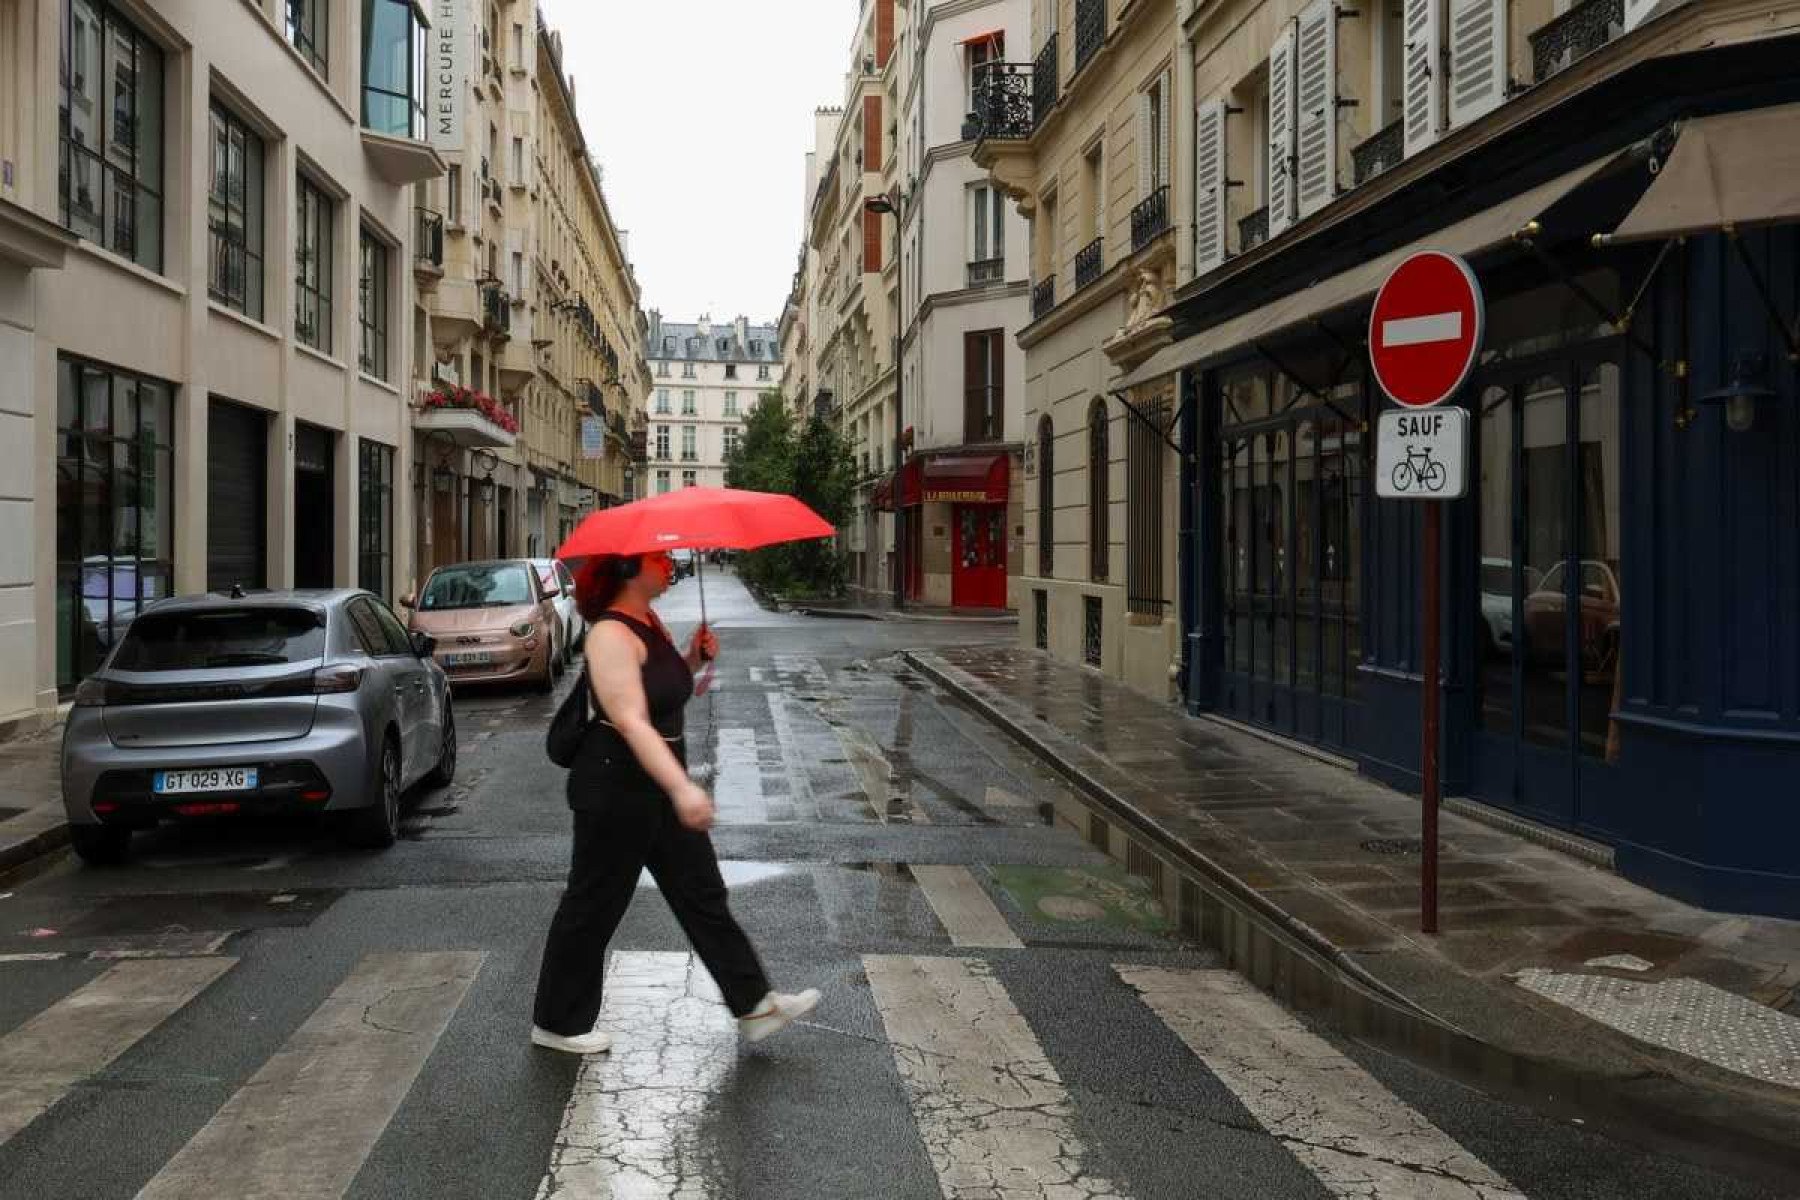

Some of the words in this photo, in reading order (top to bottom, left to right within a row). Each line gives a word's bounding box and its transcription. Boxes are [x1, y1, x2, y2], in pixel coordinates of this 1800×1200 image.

[441, 0, 453, 17] H
[440, 28, 453, 134] MERCURE
[1397, 414, 1443, 436] SAUF
